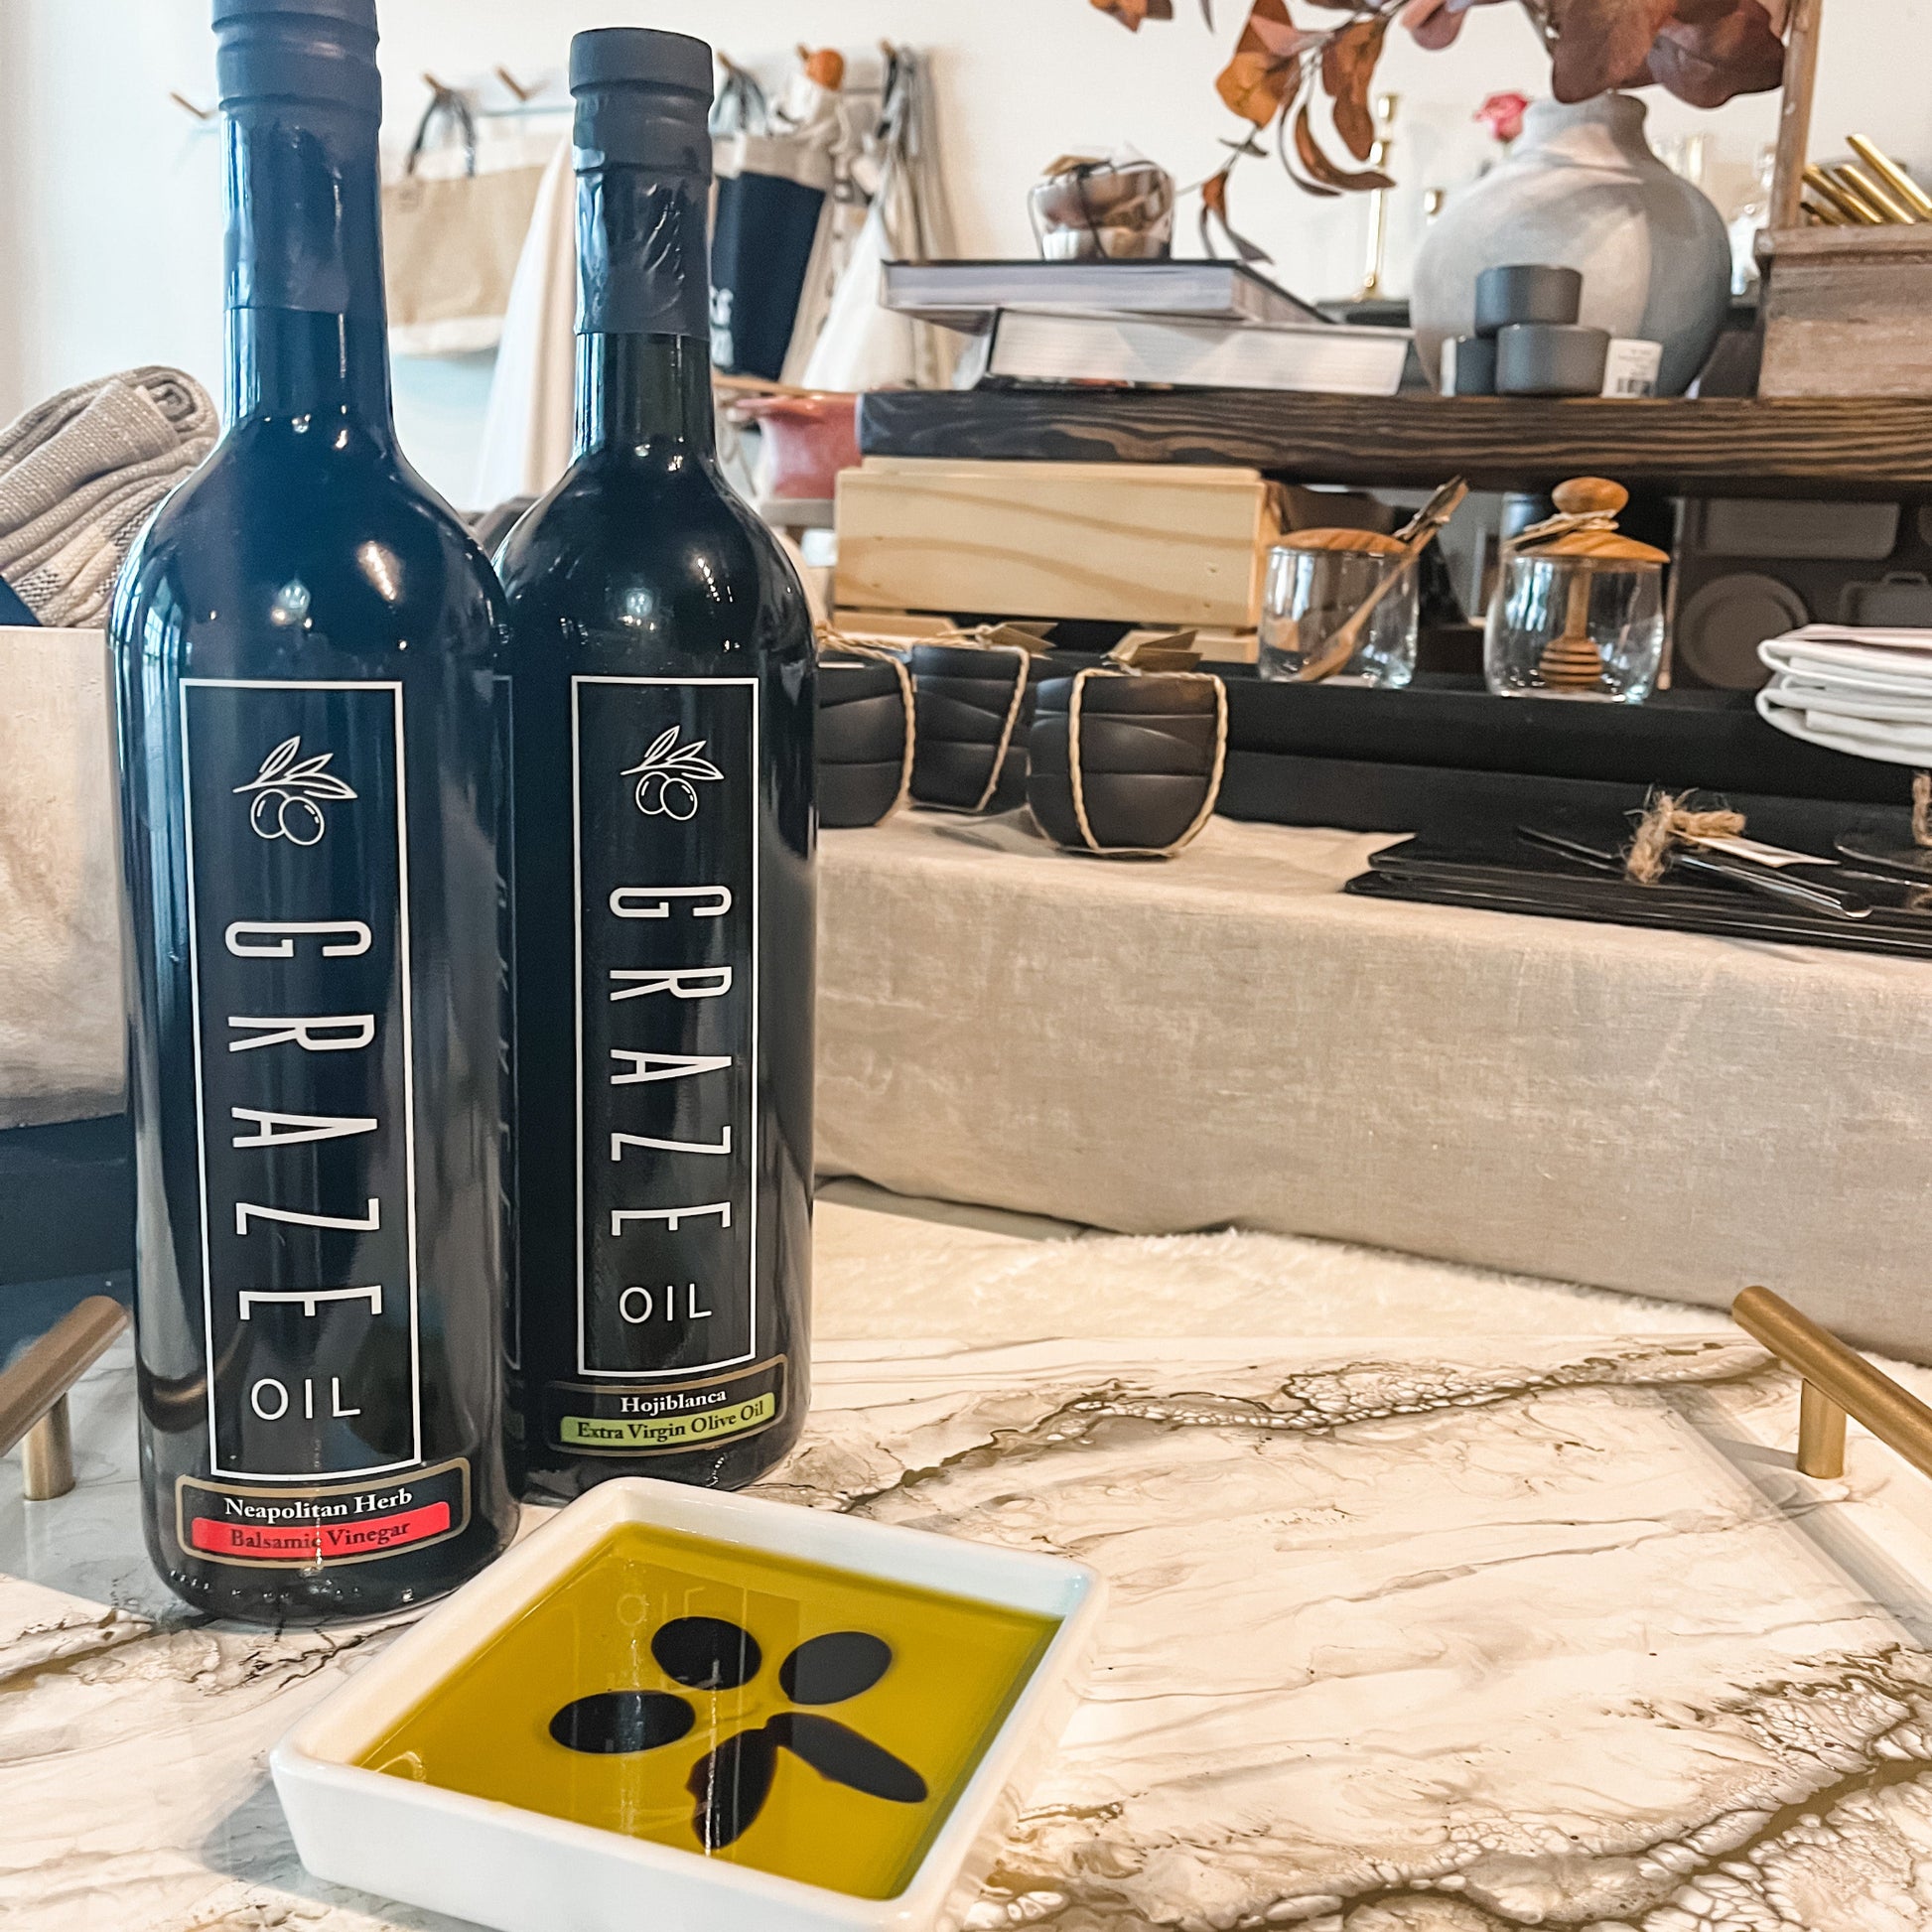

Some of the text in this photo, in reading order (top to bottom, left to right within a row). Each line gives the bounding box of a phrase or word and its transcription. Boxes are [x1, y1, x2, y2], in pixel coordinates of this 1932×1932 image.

[610, 885, 733, 1237] GRAZE
[224, 920, 382, 1320] GRAZE
[619, 1283, 713, 1323] OIL
[250, 1376, 361, 1421] OIL
[621, 1391, 727, 1417] Hojiblanca
[577, 1400, 763, 1443] Extra Virgin Olive Oil
[223, 1488, 413, 1525] Neapolitan Herb
[229, 1520, 411, 1550] Balsamic Vinegar
